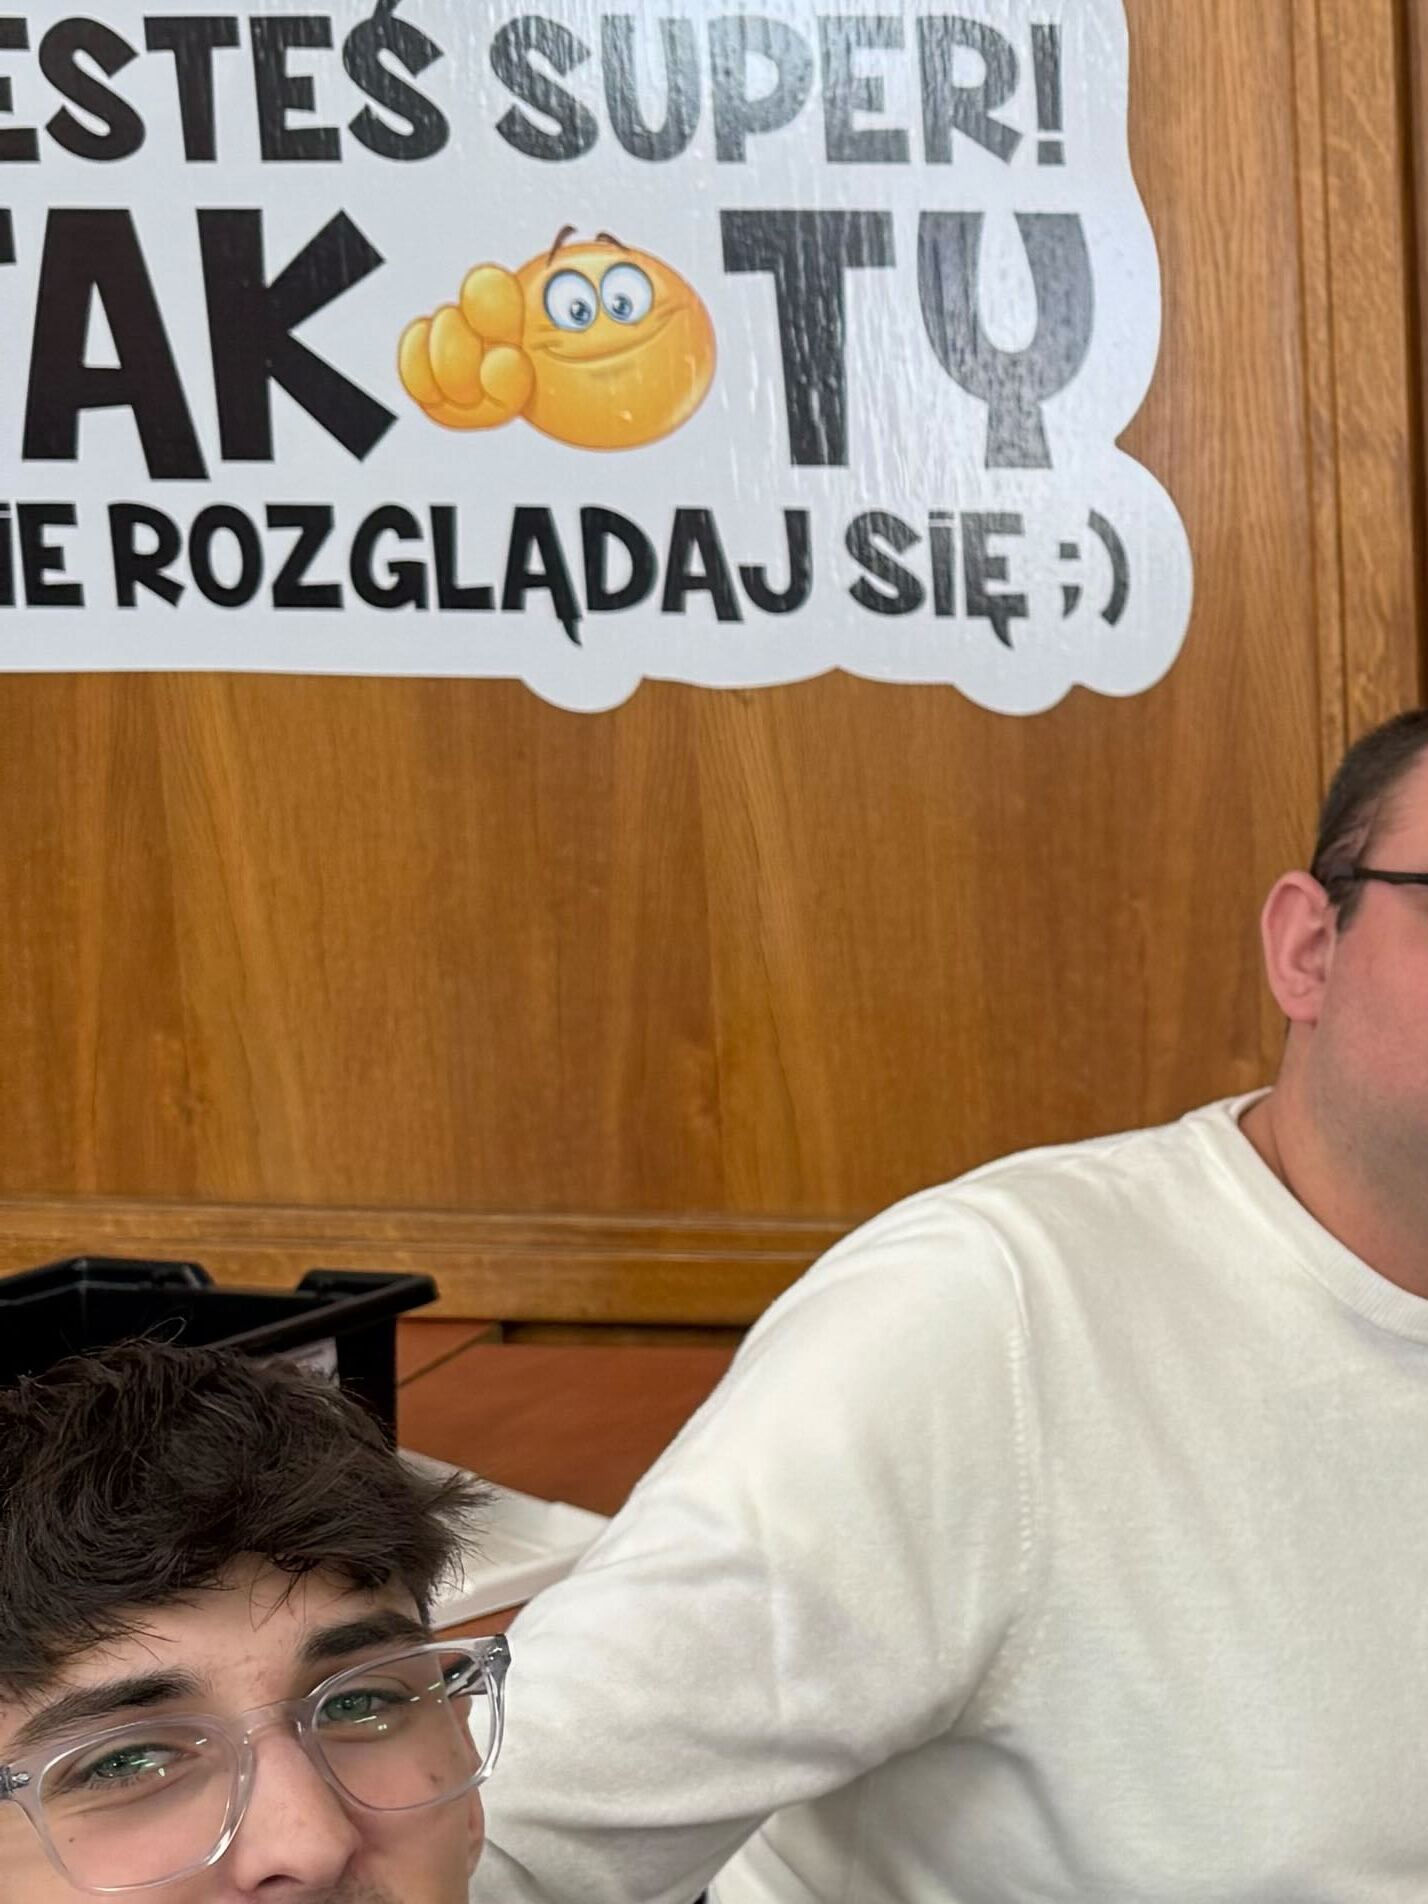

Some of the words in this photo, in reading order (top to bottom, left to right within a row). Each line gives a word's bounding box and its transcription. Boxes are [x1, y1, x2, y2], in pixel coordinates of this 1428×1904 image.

[490, 13, 1066, 167] SUPER!
[0, 208, 399, 480] AK
[719, 210, 1095, 470] TY
[108, 501, 812, 646] ROZGLĄDAJ
